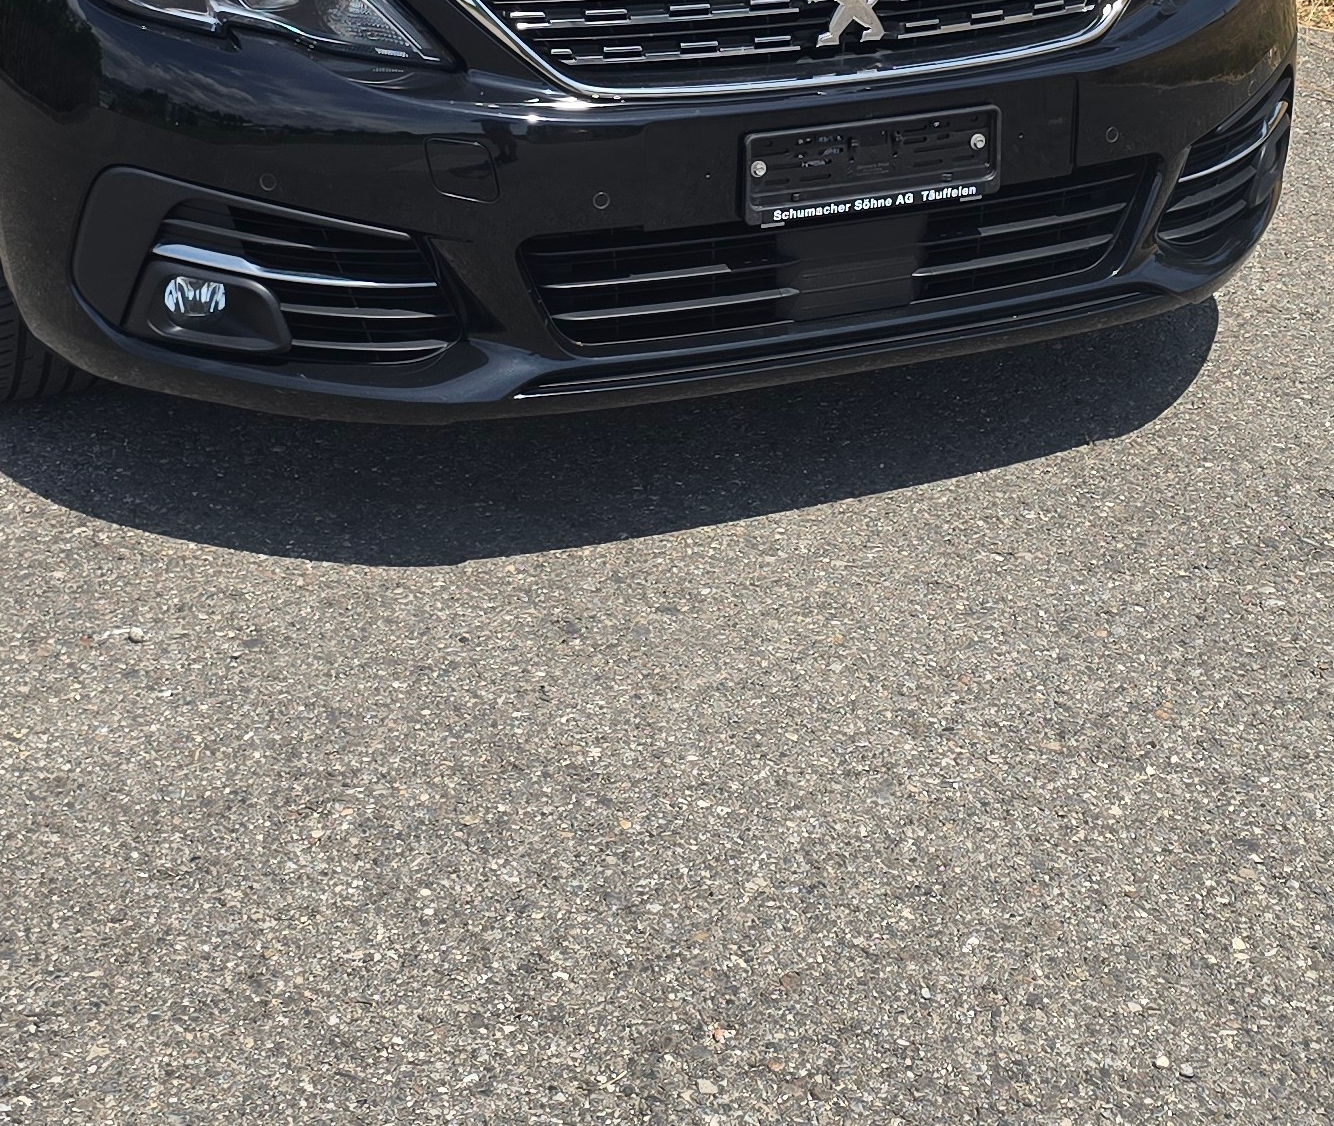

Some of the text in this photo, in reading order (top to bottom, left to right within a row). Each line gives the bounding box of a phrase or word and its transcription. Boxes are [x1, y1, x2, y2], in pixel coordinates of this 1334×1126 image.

[772, 185, 977, 221] Schumacher Söhne AG Täuffelen
